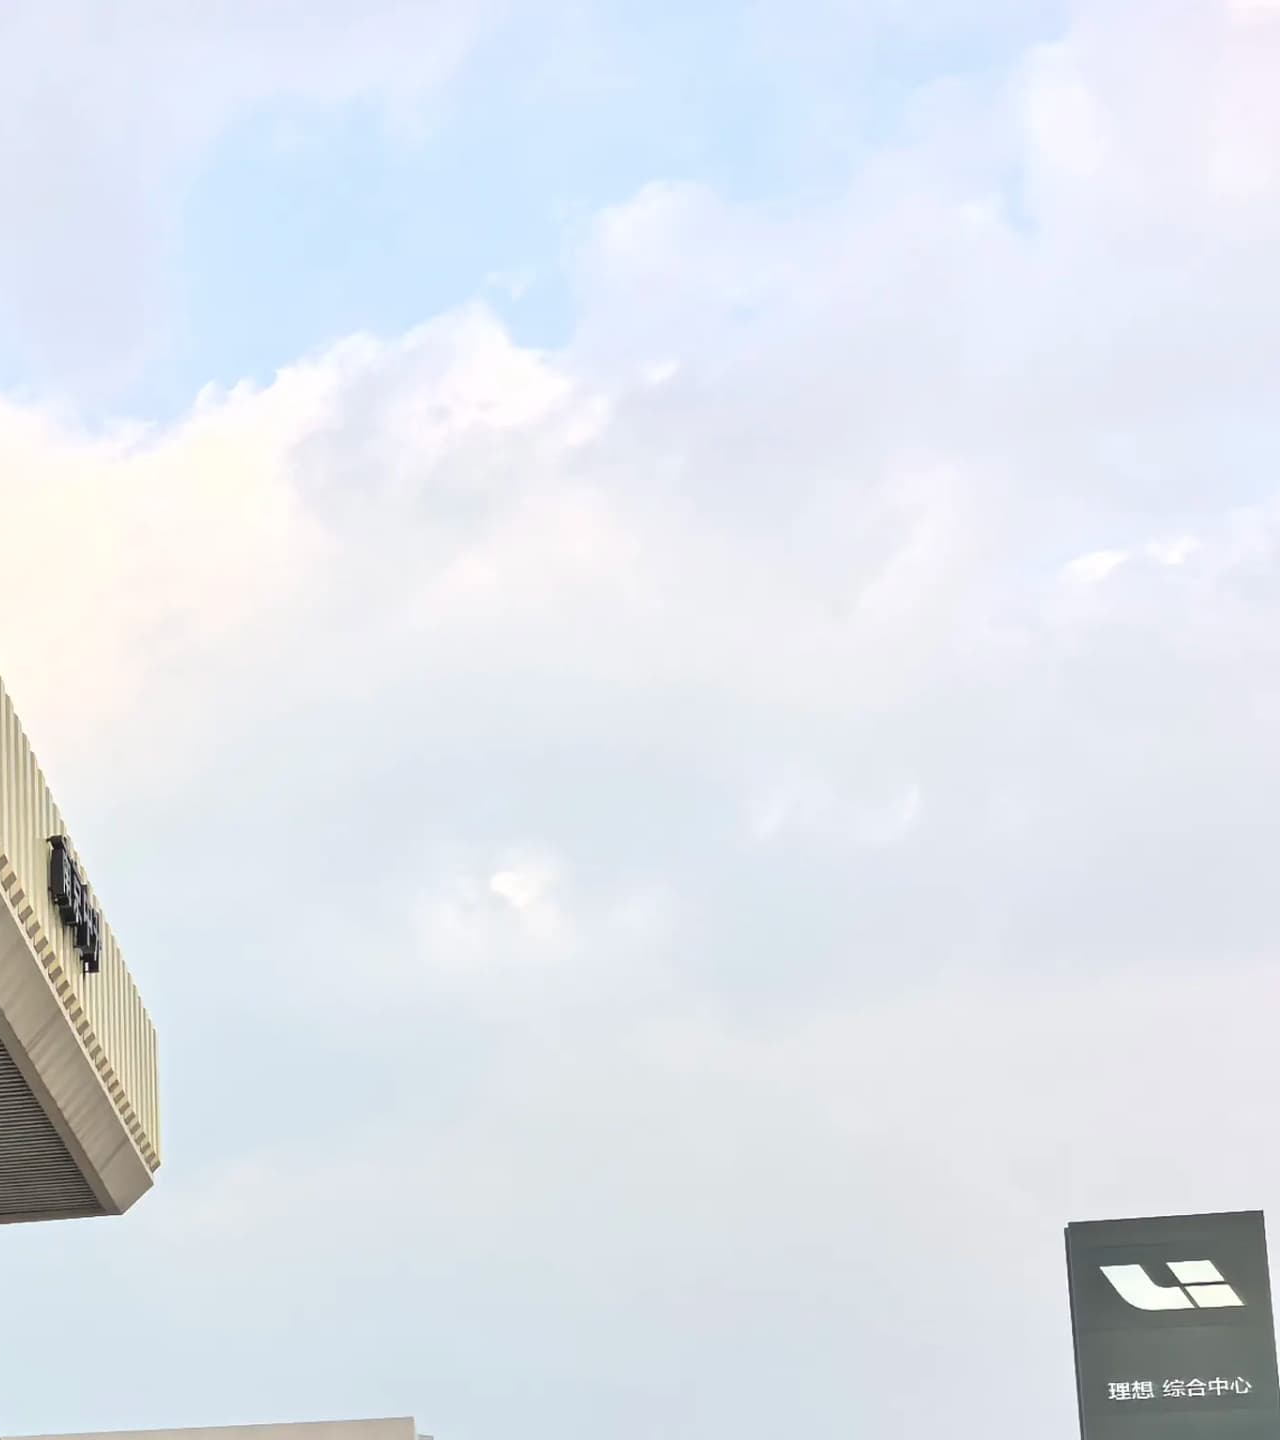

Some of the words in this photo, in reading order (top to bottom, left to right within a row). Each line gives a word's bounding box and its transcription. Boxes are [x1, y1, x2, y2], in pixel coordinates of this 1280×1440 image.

[1107, 1380, 1154, 1401] 理想
[1162, 1376, 1252, 1398] 综合中心
